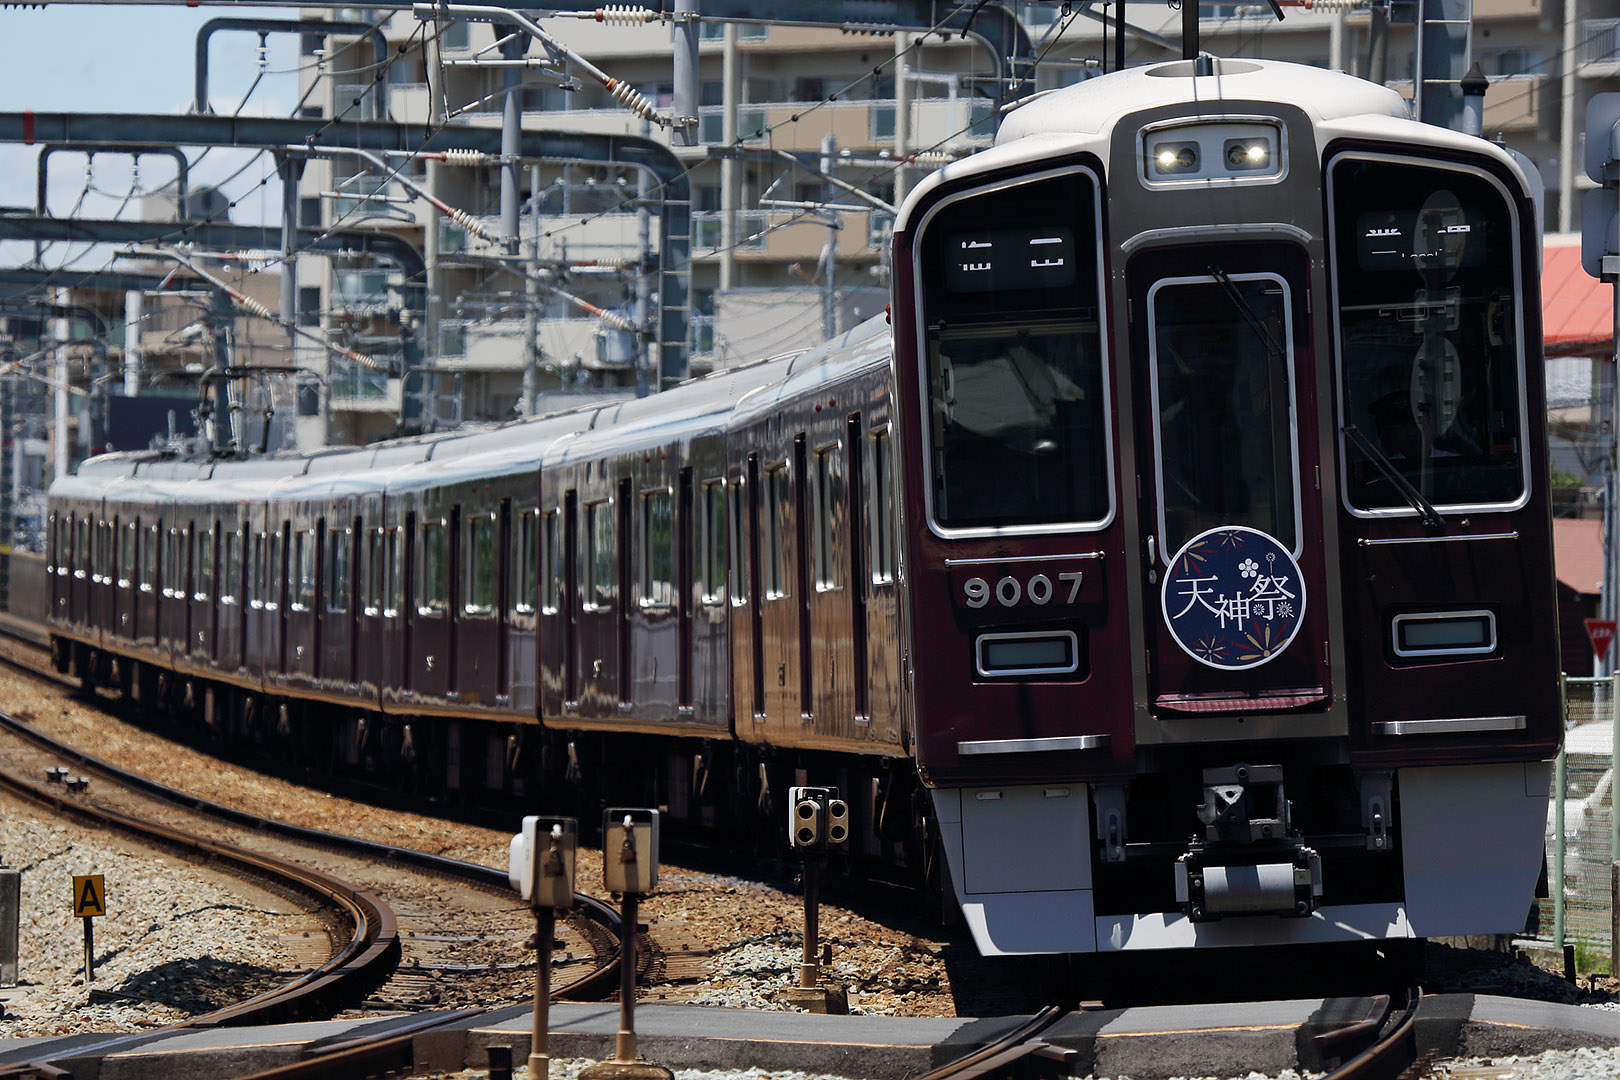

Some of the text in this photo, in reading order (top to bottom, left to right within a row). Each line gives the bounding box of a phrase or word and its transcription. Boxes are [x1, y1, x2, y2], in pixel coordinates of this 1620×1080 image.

[964, 572, 1083, 608] 9007
[1173, 574, 1296, 631] 天神祭
[78, 879, 102, 913] A
